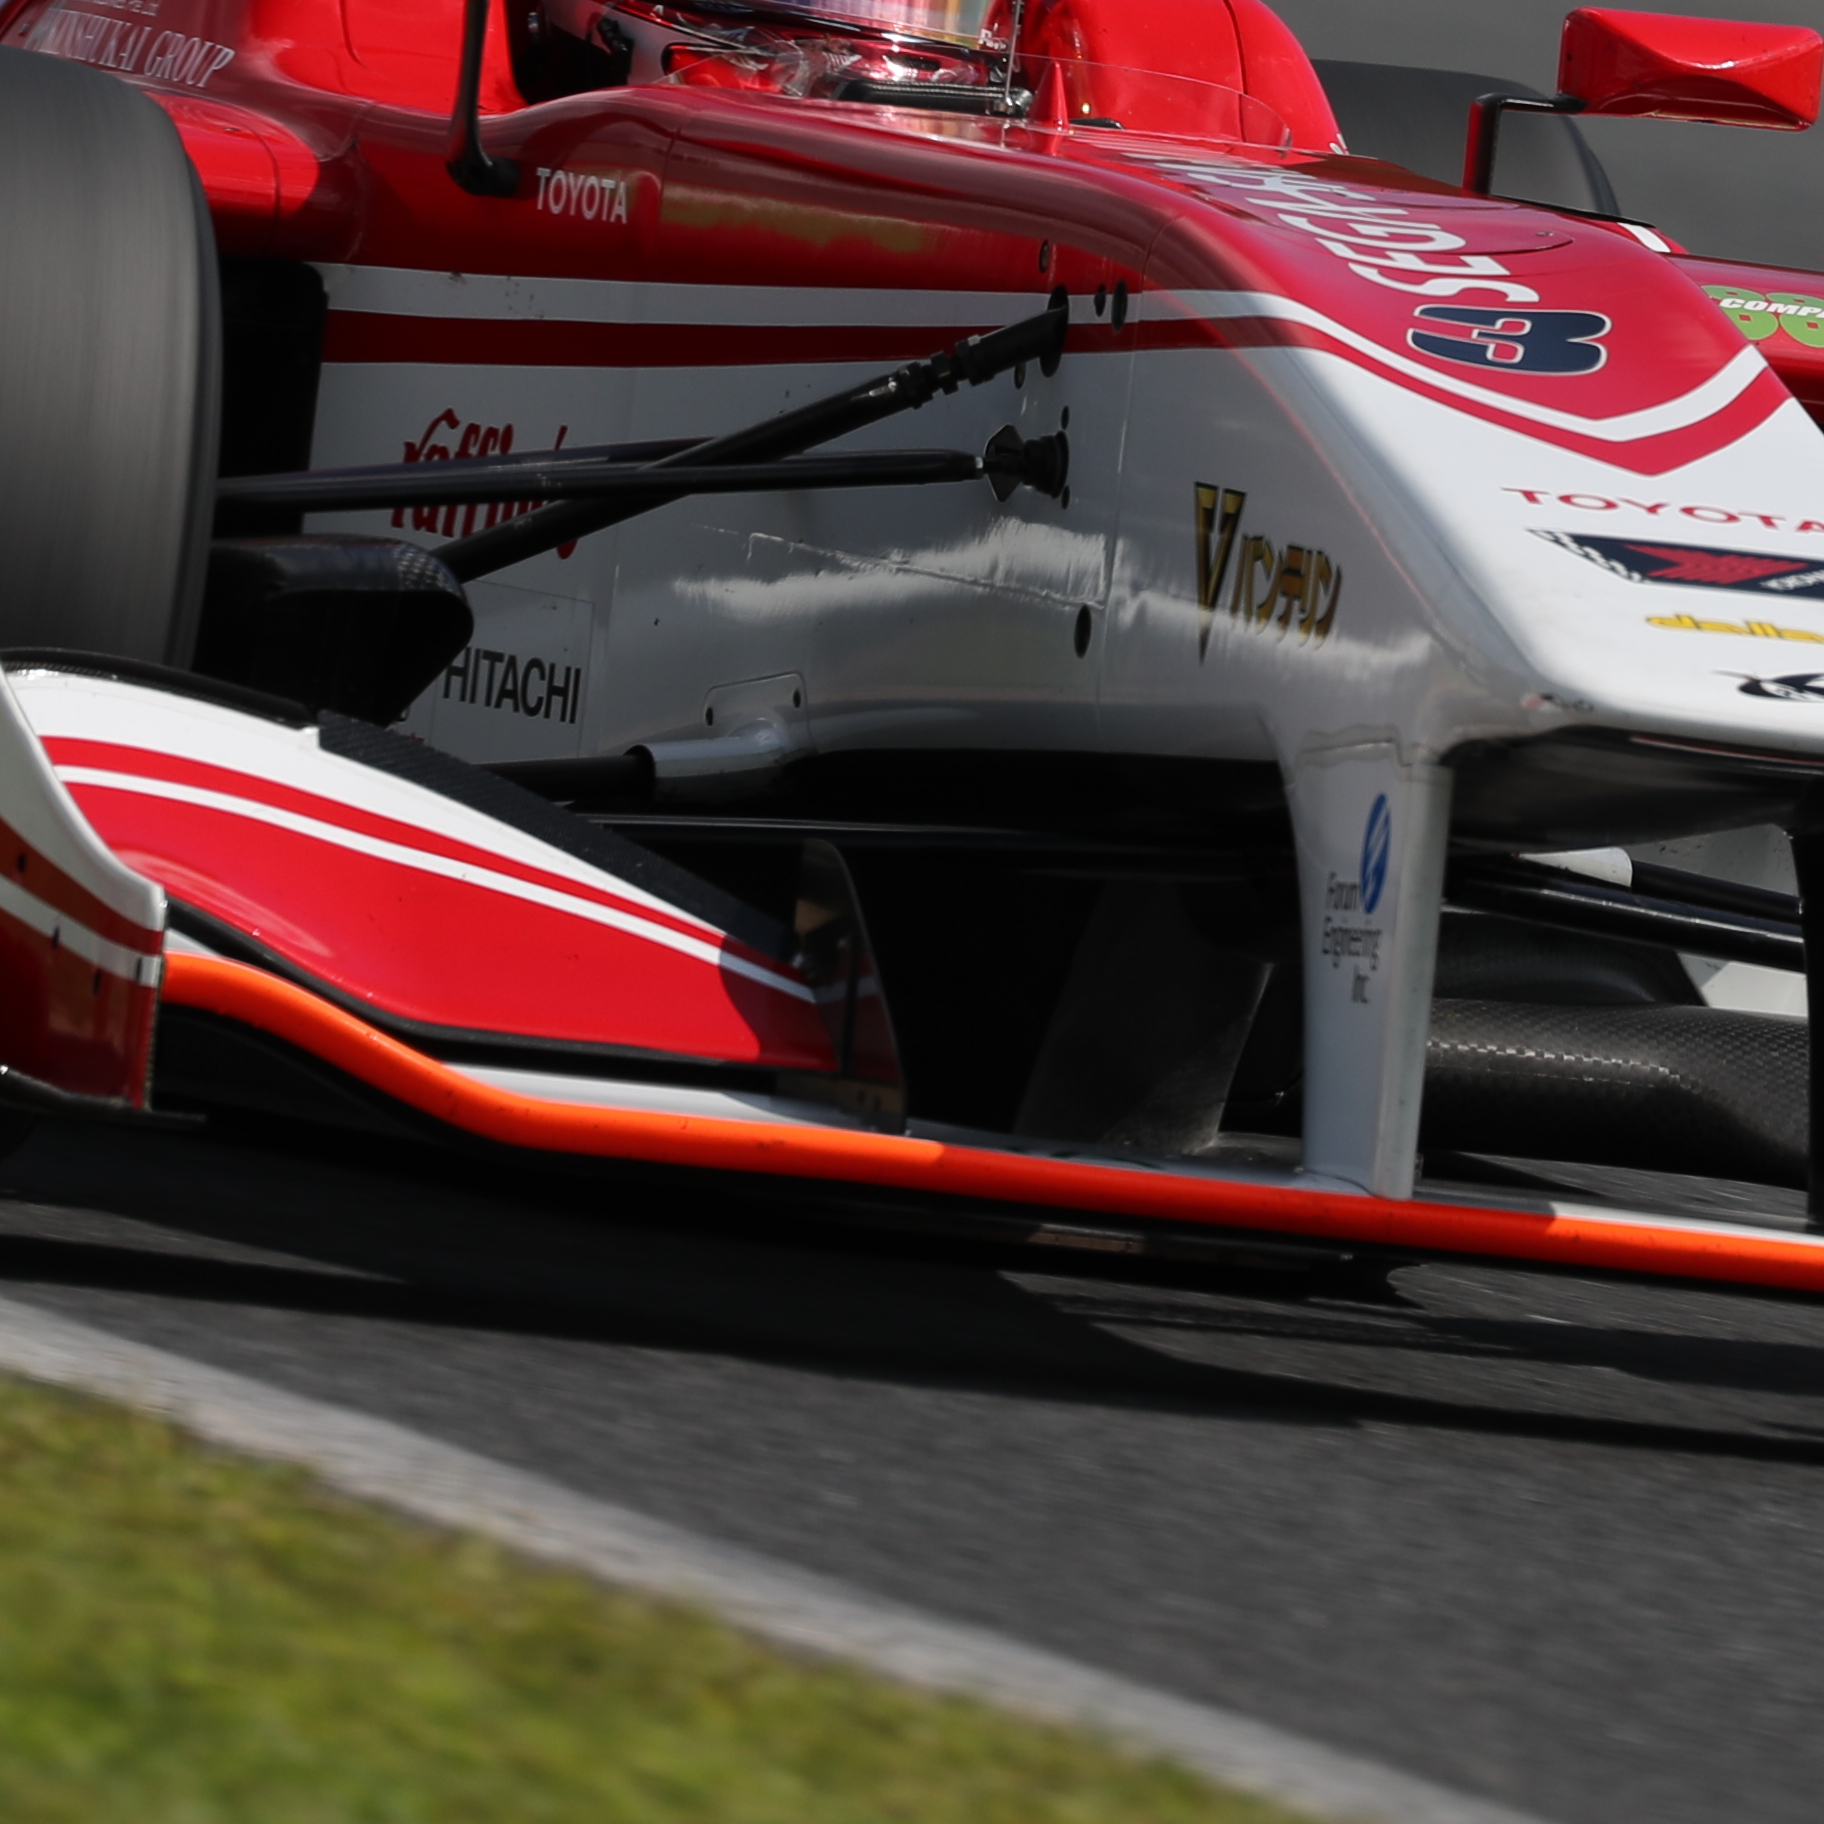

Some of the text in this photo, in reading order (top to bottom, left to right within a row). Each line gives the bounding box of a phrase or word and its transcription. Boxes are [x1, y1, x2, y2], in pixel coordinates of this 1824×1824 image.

[143, 29, 235, 88] GROUP
[536, 166, 628, 224] TOYOTA
[1406, 303, 1612, 376] 3
[442, 644, 583, 725] HITACHI
